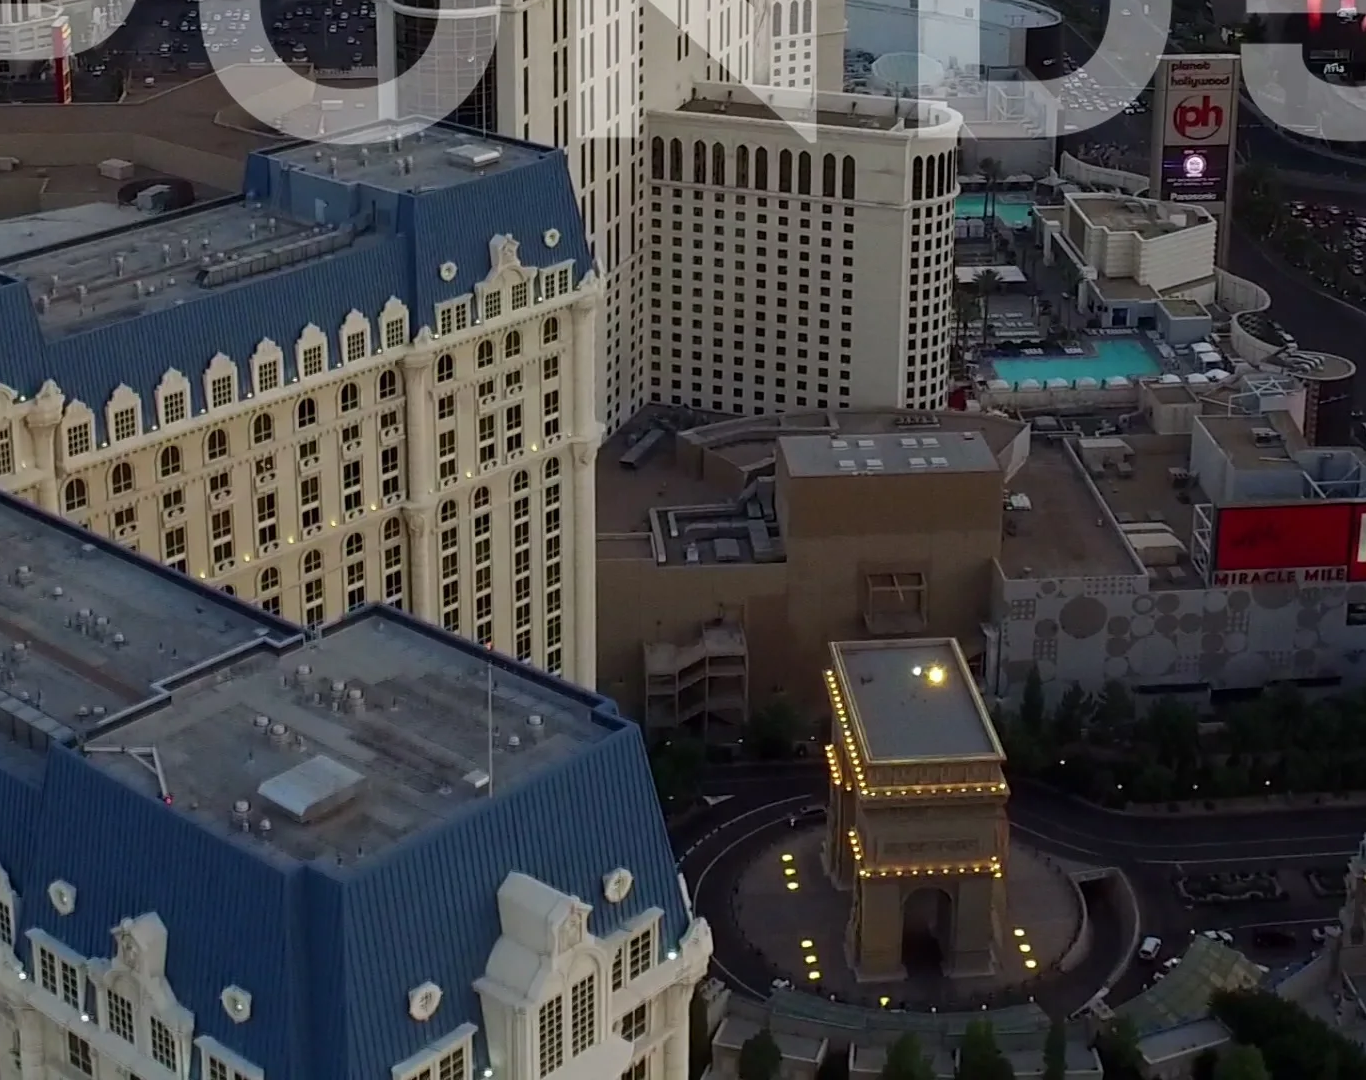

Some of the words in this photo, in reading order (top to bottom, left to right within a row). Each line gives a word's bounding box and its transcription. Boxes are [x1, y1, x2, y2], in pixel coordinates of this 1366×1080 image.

[1171, 61, 1211, 72] planet
[1171, 76, 1230, 88] hollywood
[1174, 95, 1223, 139] ph
[1170, 192, 1217, 201] Panasonic
[1214, 571, 1296, 587] MIRACLE
[1304, 568, 1346, 582] MILE
